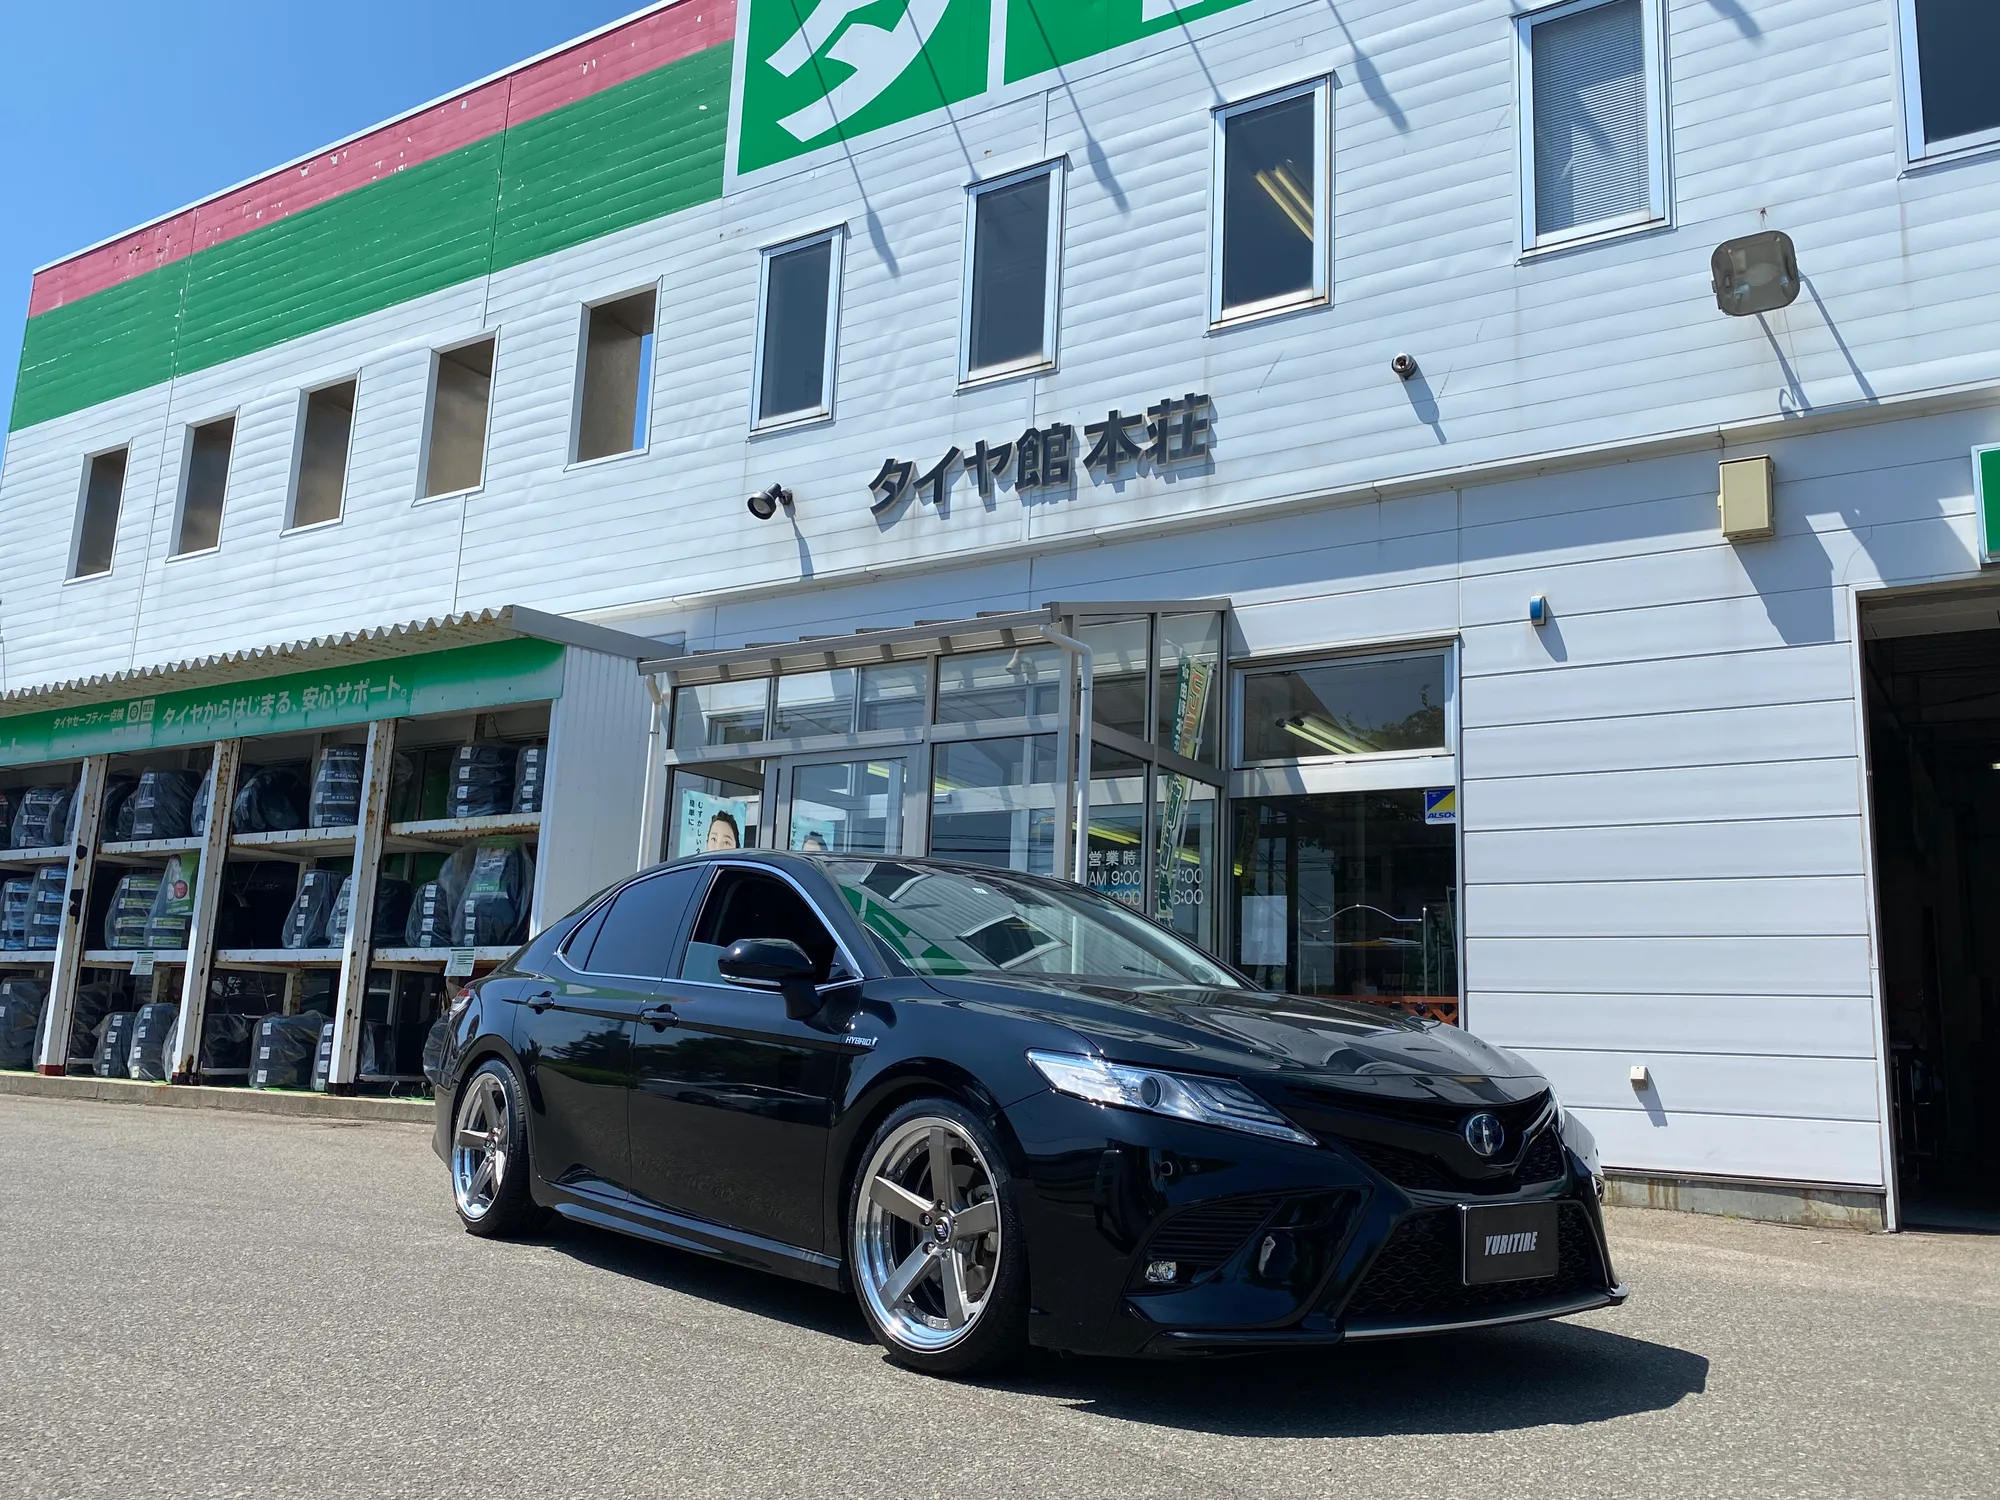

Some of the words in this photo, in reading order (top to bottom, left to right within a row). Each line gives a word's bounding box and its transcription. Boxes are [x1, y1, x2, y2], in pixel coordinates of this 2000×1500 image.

[1427, 812, 1456, 821] ALSOK
[1088, 850, 1137, 867] 営業時
[1088, 871, 1107, 886] AM
[1111, 869, 1141, 886] 9:00
[845, 1036, 872, 1046] HYBRID
[1484, 1231, 1538, 1256] YURITIRE
